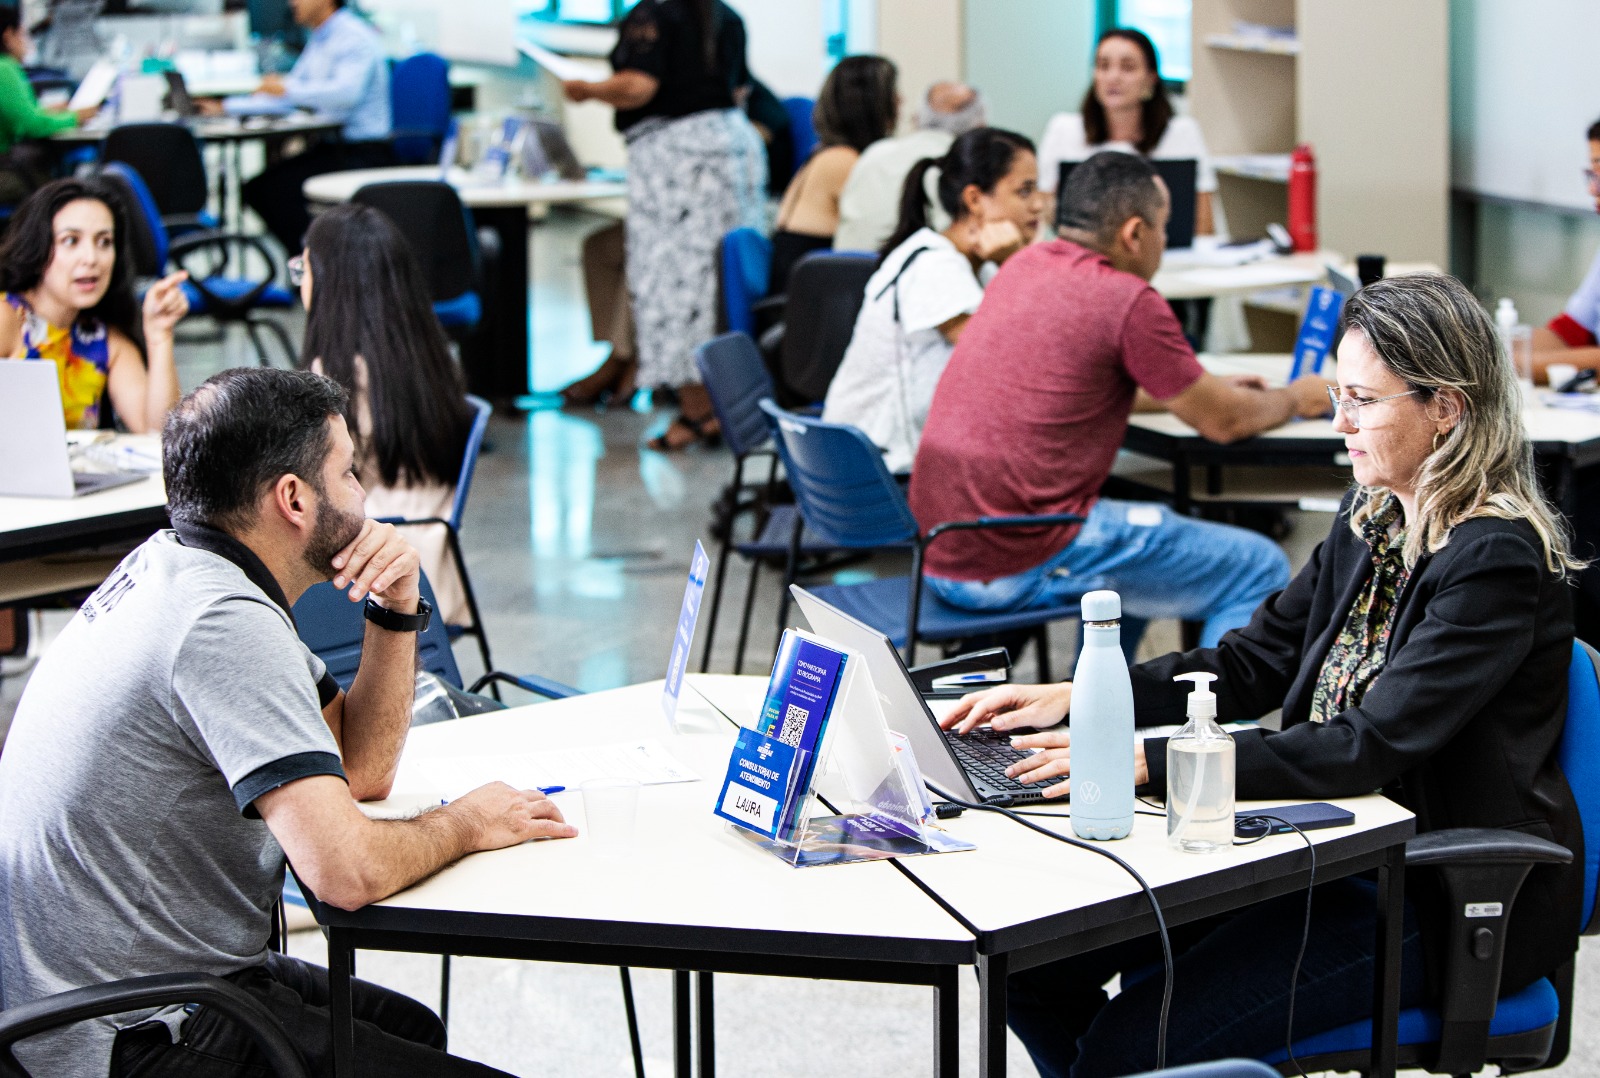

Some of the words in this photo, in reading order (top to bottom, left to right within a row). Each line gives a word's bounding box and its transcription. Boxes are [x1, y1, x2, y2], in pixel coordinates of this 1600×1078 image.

[739, 758, 772, 780] CONSULTOR(A)
[771, 771, 780, 781] DE
[739, 770, 771, 790] ATENDIMENTO
[735, 795, 761, 818] LAURA
